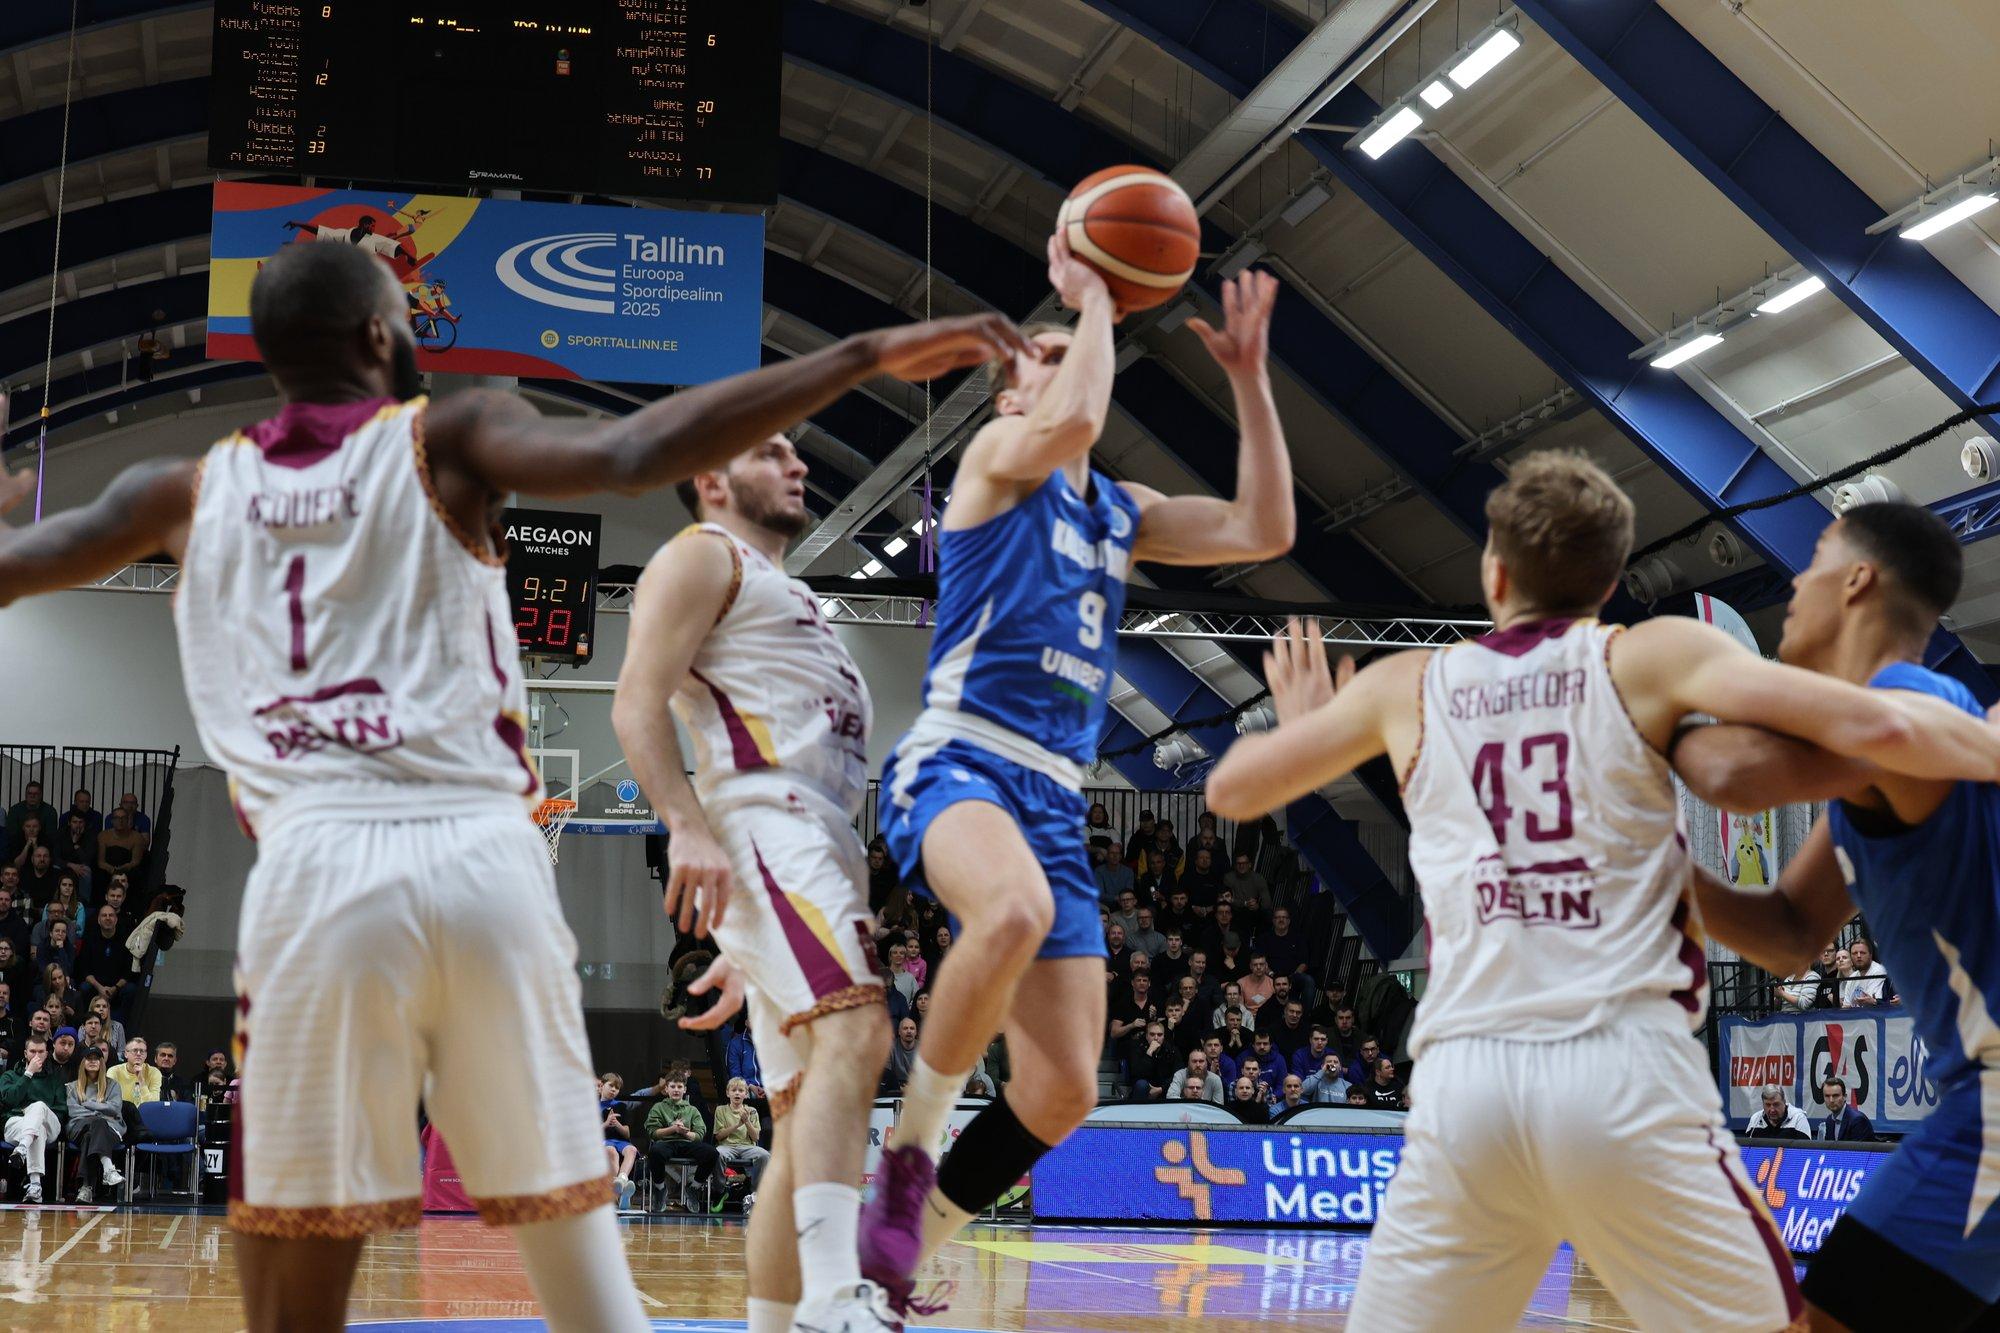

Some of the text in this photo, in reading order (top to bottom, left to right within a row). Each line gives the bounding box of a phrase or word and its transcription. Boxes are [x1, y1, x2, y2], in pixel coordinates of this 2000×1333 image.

[322, 5, 331, 18] 8
[707, 34, 716, 47] 6
[315, 73, 328, 86] 12
[696, 101, 714, 113] 20
[308, 141, 325, 153] 33
[696, 167, 712, 179] 77
[624, 234, 724, 266] Tallinn
[623, 264, 684, 283] Euroopa
[622, 283, 723, 302] Spordipealinn
[621, 302, 661, 317] 2025
[567, 335, 678, 351] SPORT.TALLINN.EE
[504, 525, 592, 546] AEGAON
[525, 545, 569, 556] WATCHES
[284, 554, 307, 672] 1
[1078, 590, 1107, 650] 9
[1473, 733, 1573, 845] 43
[1732, 1060, 1793, 1082] CRAMO
[1262, 1136, 1397, 1178] Linus
[1798, 1153, 1865, 1202] Linus
[1782, 1206, 1847, 1253] Med
